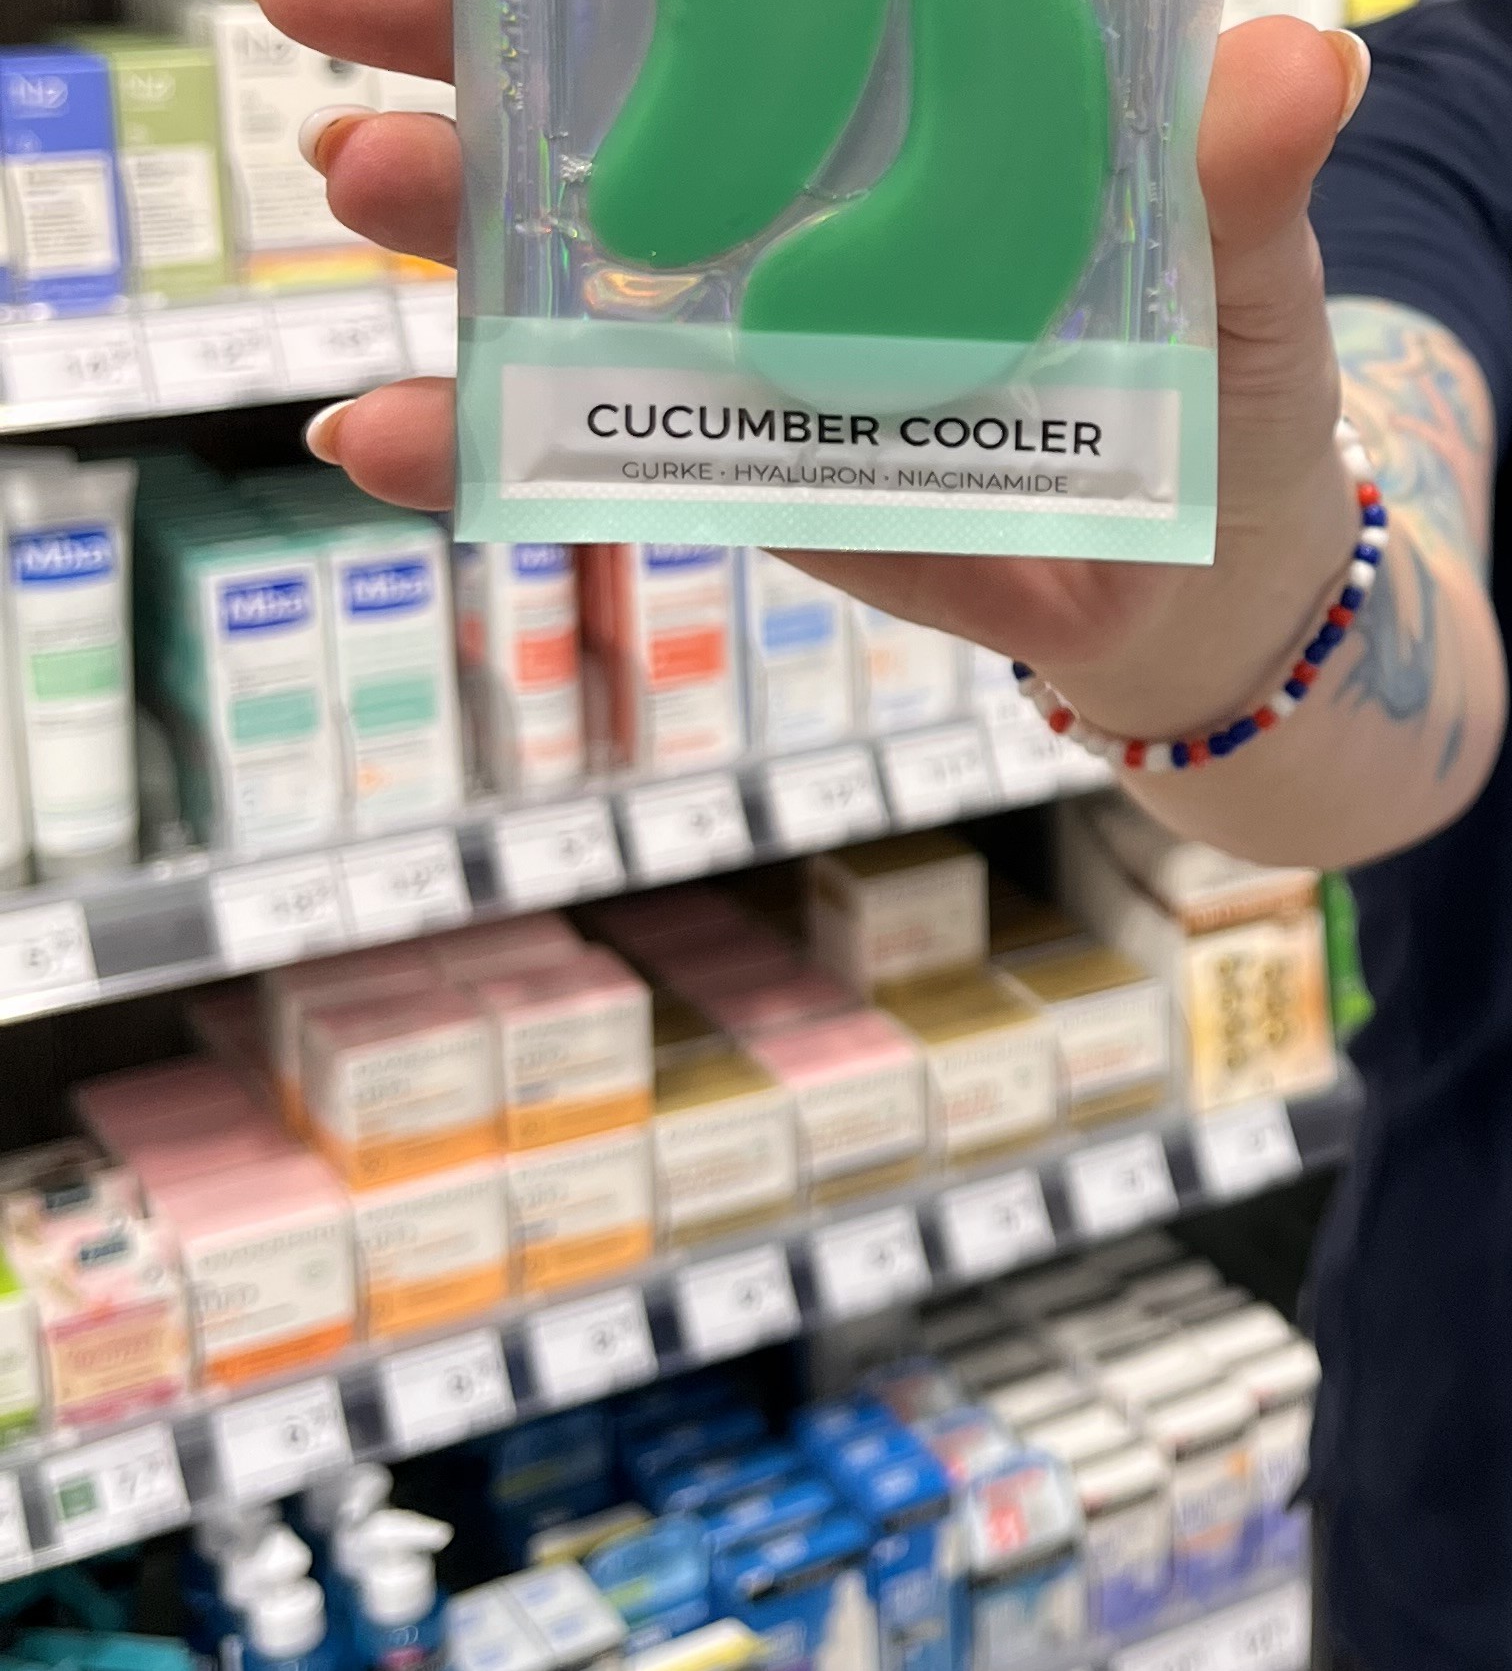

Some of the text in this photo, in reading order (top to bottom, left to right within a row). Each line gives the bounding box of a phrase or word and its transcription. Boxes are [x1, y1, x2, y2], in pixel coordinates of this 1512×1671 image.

[586, 403, 1102, 456] CUCUMBER COOLER
[622, 460, 1068, 494] GURKE HYALURON NIACINAMIDE
